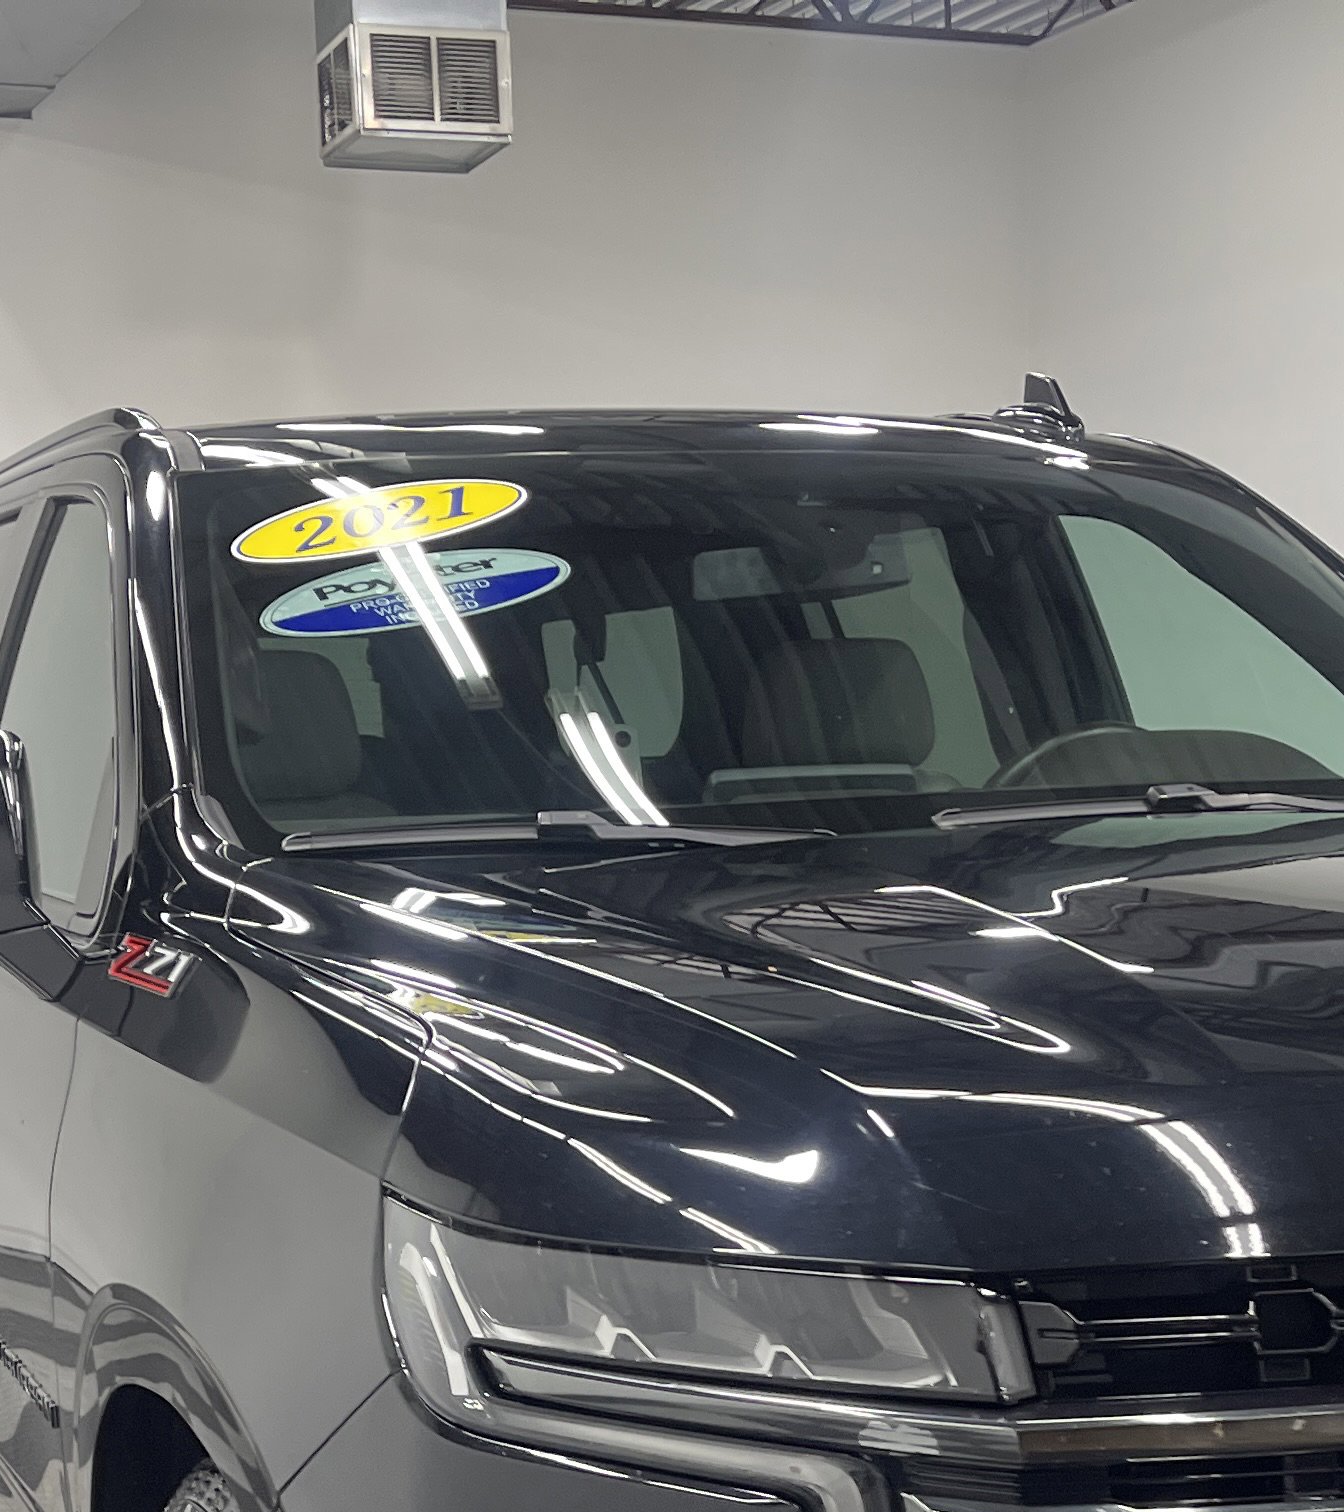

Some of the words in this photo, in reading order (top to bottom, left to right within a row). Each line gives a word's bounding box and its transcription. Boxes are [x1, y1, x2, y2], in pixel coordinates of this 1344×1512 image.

[294, 486, 473, 553] 2021
[312, 557, 498, 601] Poyter
[108, 932, 193, 997] Z71
